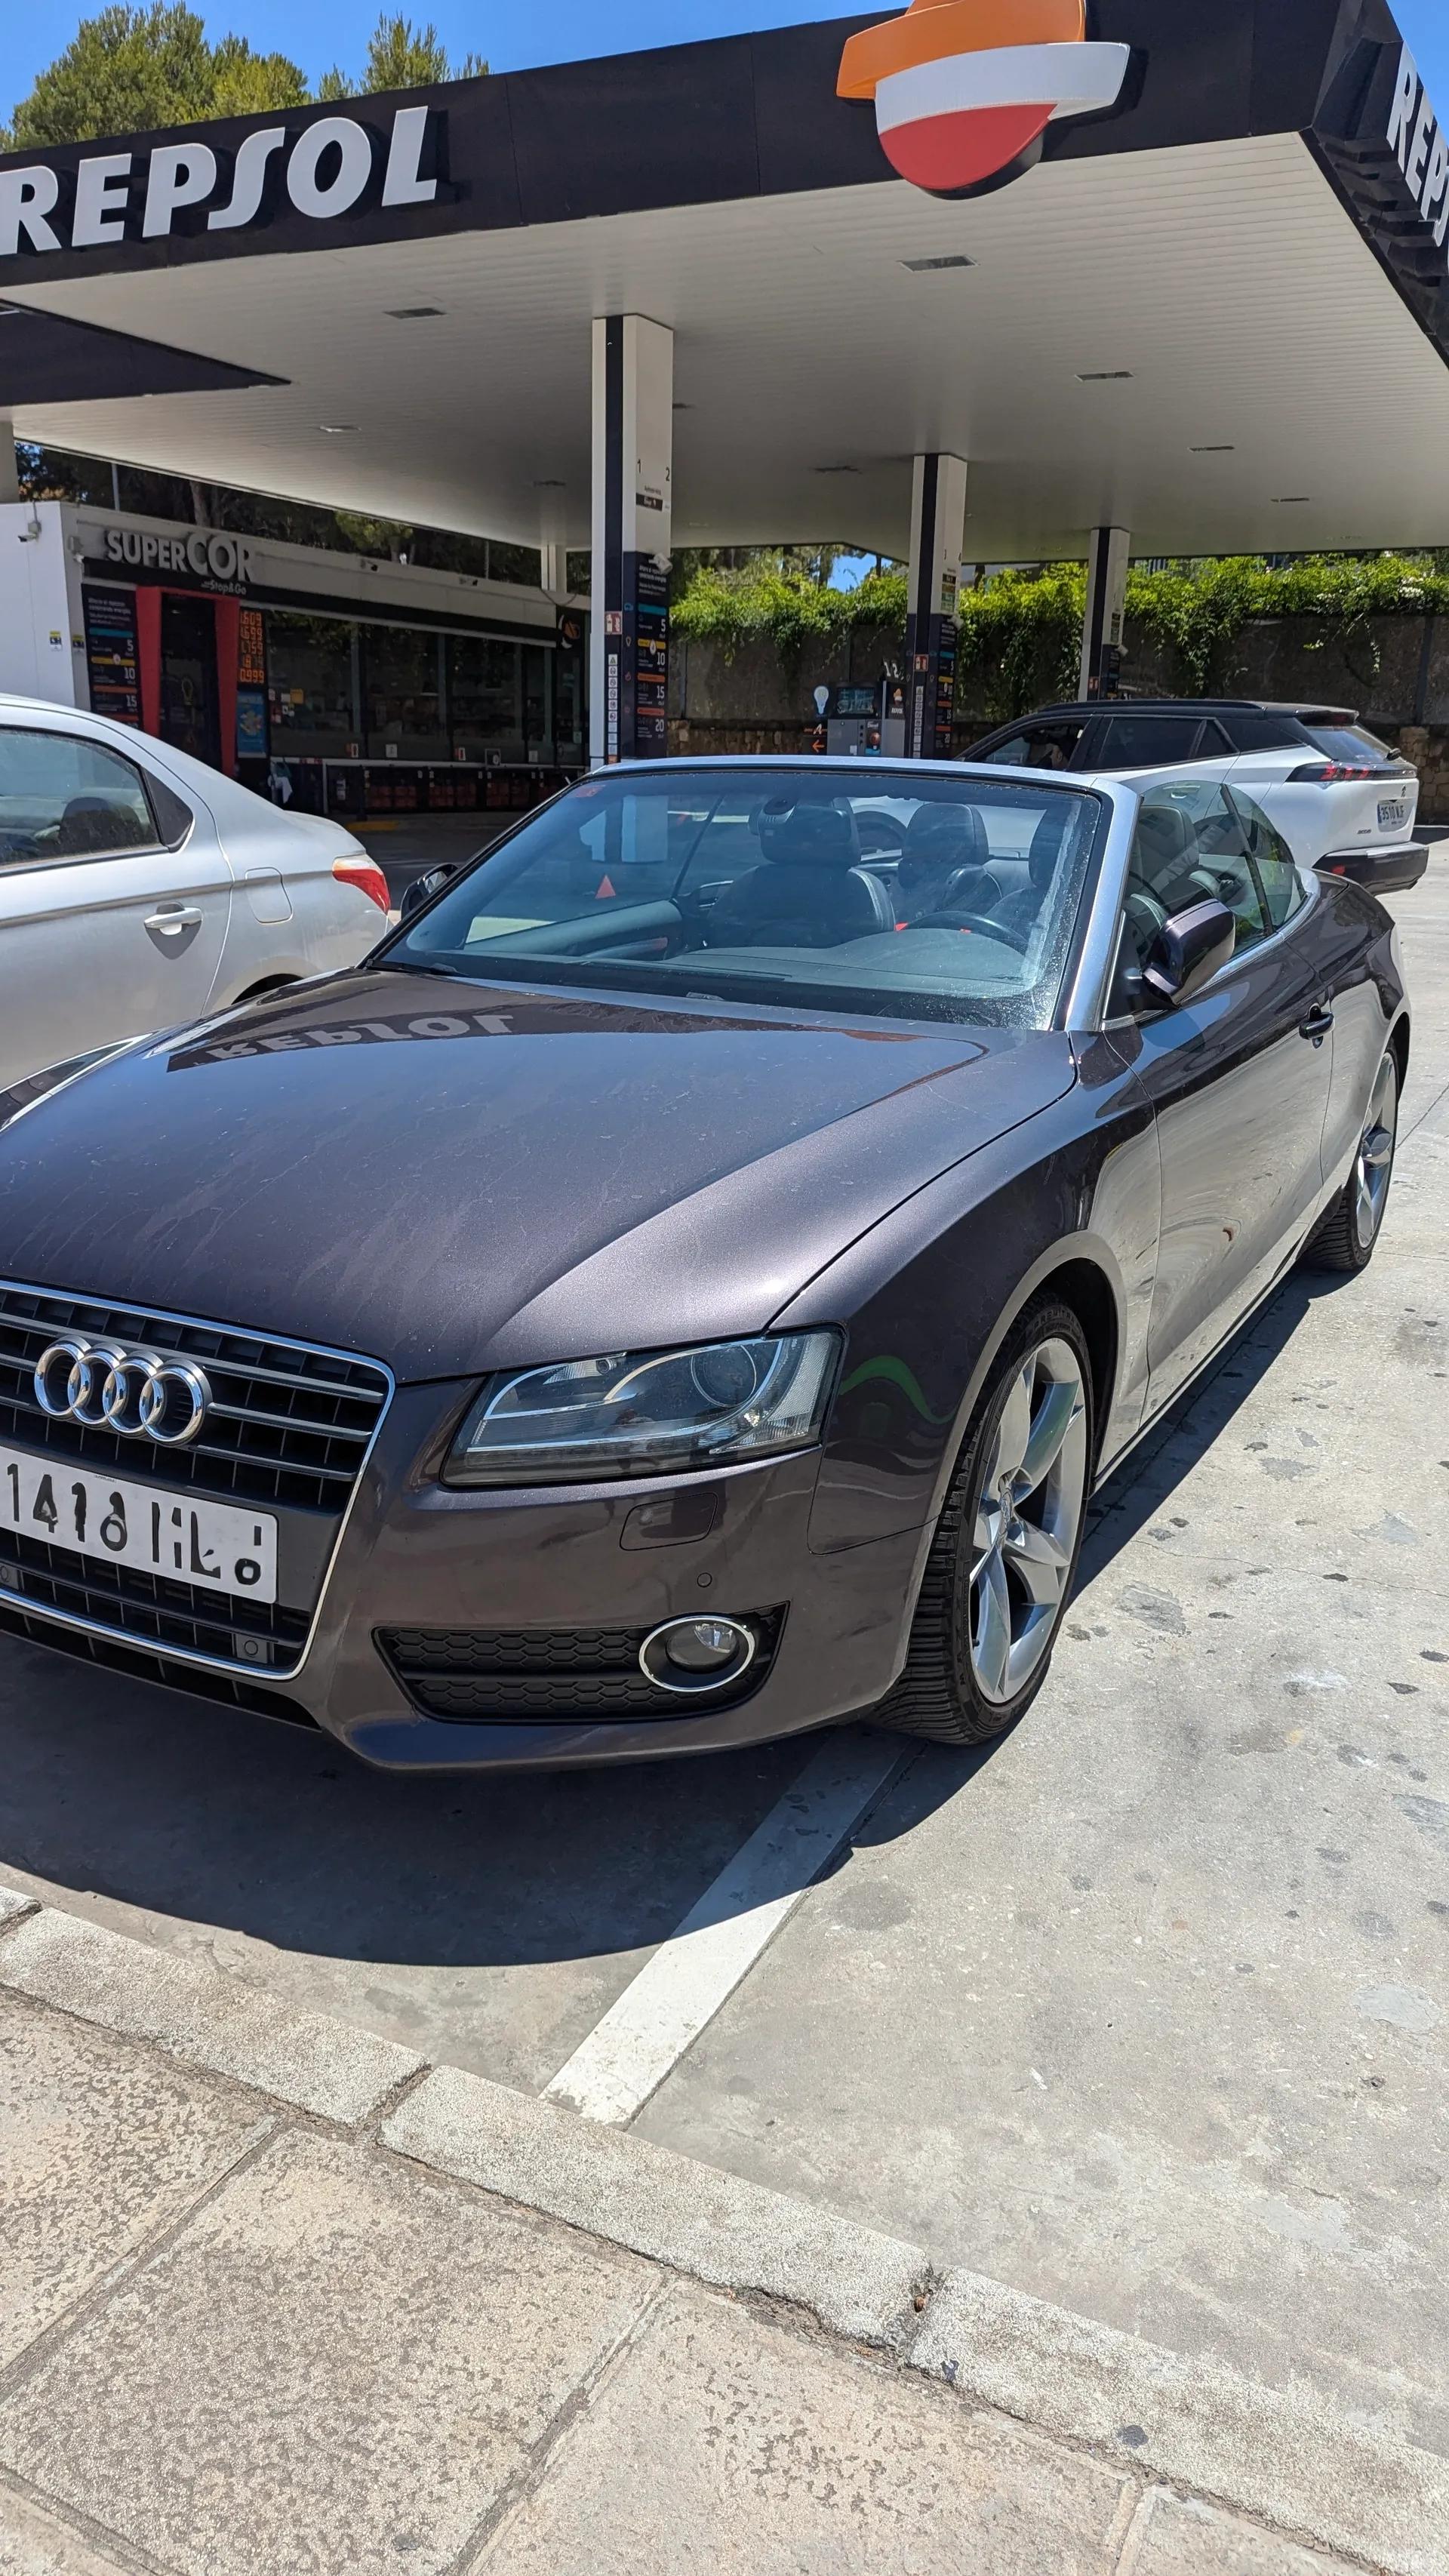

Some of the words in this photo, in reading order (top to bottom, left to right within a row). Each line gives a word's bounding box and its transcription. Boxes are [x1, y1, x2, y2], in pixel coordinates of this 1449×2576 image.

[0, 106, 437, 255] REPSOL
[637, 458, 641, 474] 1
[665, 466, 670, 482] 2
[107, 530, 257, 583] SUPERCOR
[660, 618, 666, 632] 5
[127, 639, 134, 652] 5
[657, 651, 666, 666] 10
[124, 667, 135, 680] 10
[657, 685, 665, 699] 15
[126, 695, 137, 708] 15
[655, 719, 664, 732] 20
